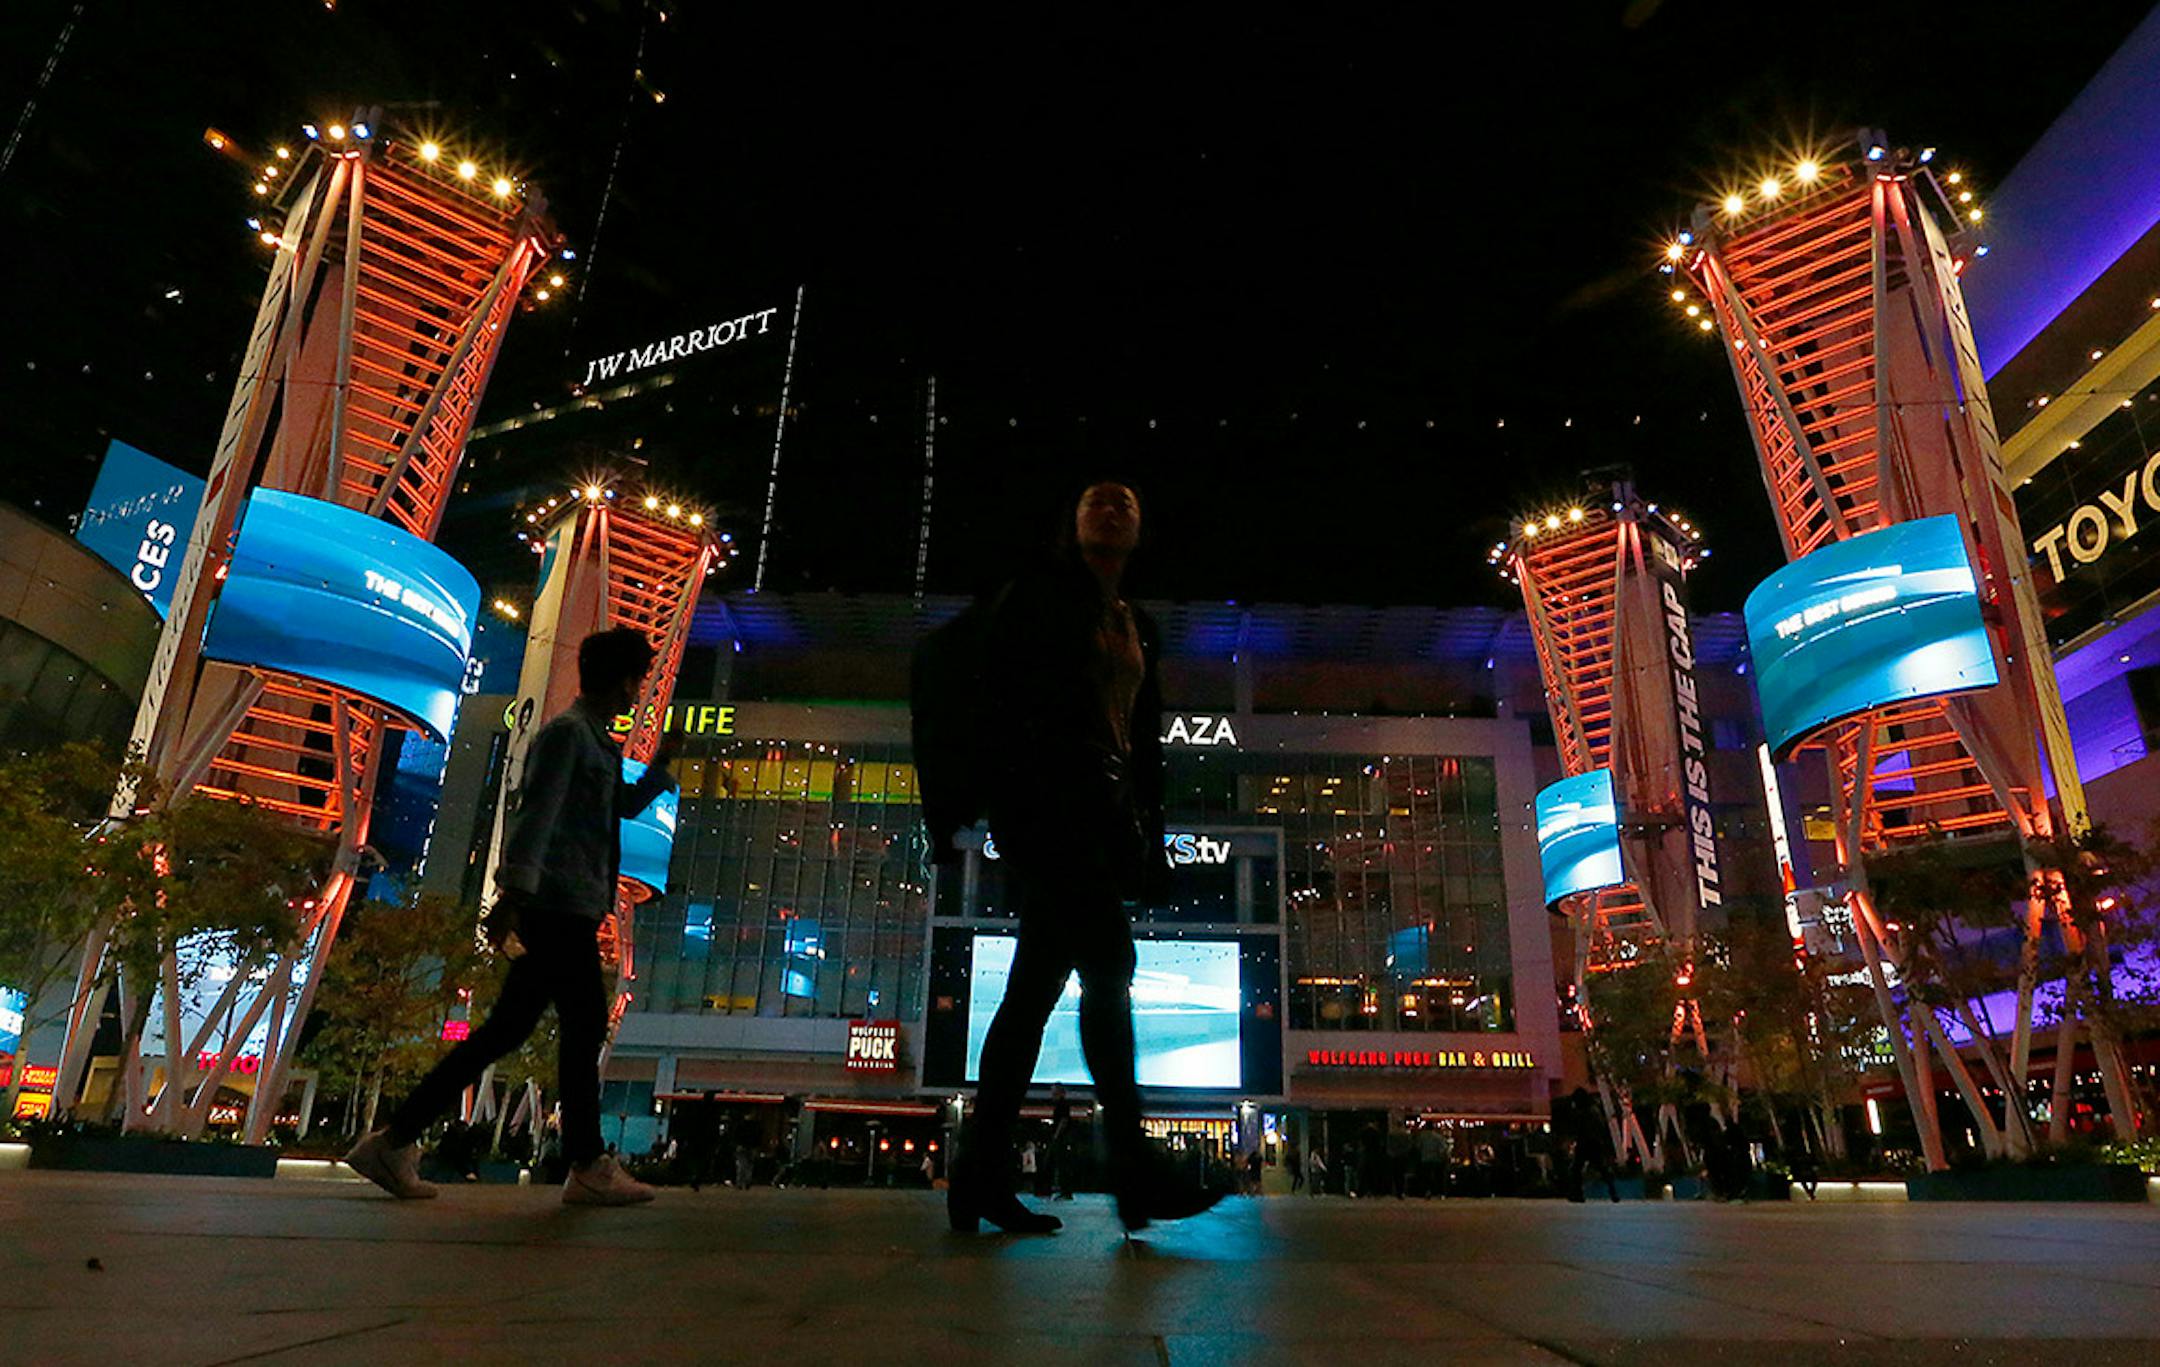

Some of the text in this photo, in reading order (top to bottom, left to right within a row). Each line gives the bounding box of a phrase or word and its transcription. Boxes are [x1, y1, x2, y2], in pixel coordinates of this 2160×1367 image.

[584, 307, 777, 386] JW MARRIOTT
[131, 519, 176, 591] CES
[1663, 581, 1693, 670] CAP
[1159, 716, 1237, 745] AZA
[1675, 669, 1704, 756] THE
[1685, 757, 1709, 804] IS
[1690, 805, 1722, 909] THIS
[849, 1037, 896, 1059] PUCK
[1308, 1051, 1534, 1068] WOLFGANG PUCK BAR & GRILL
